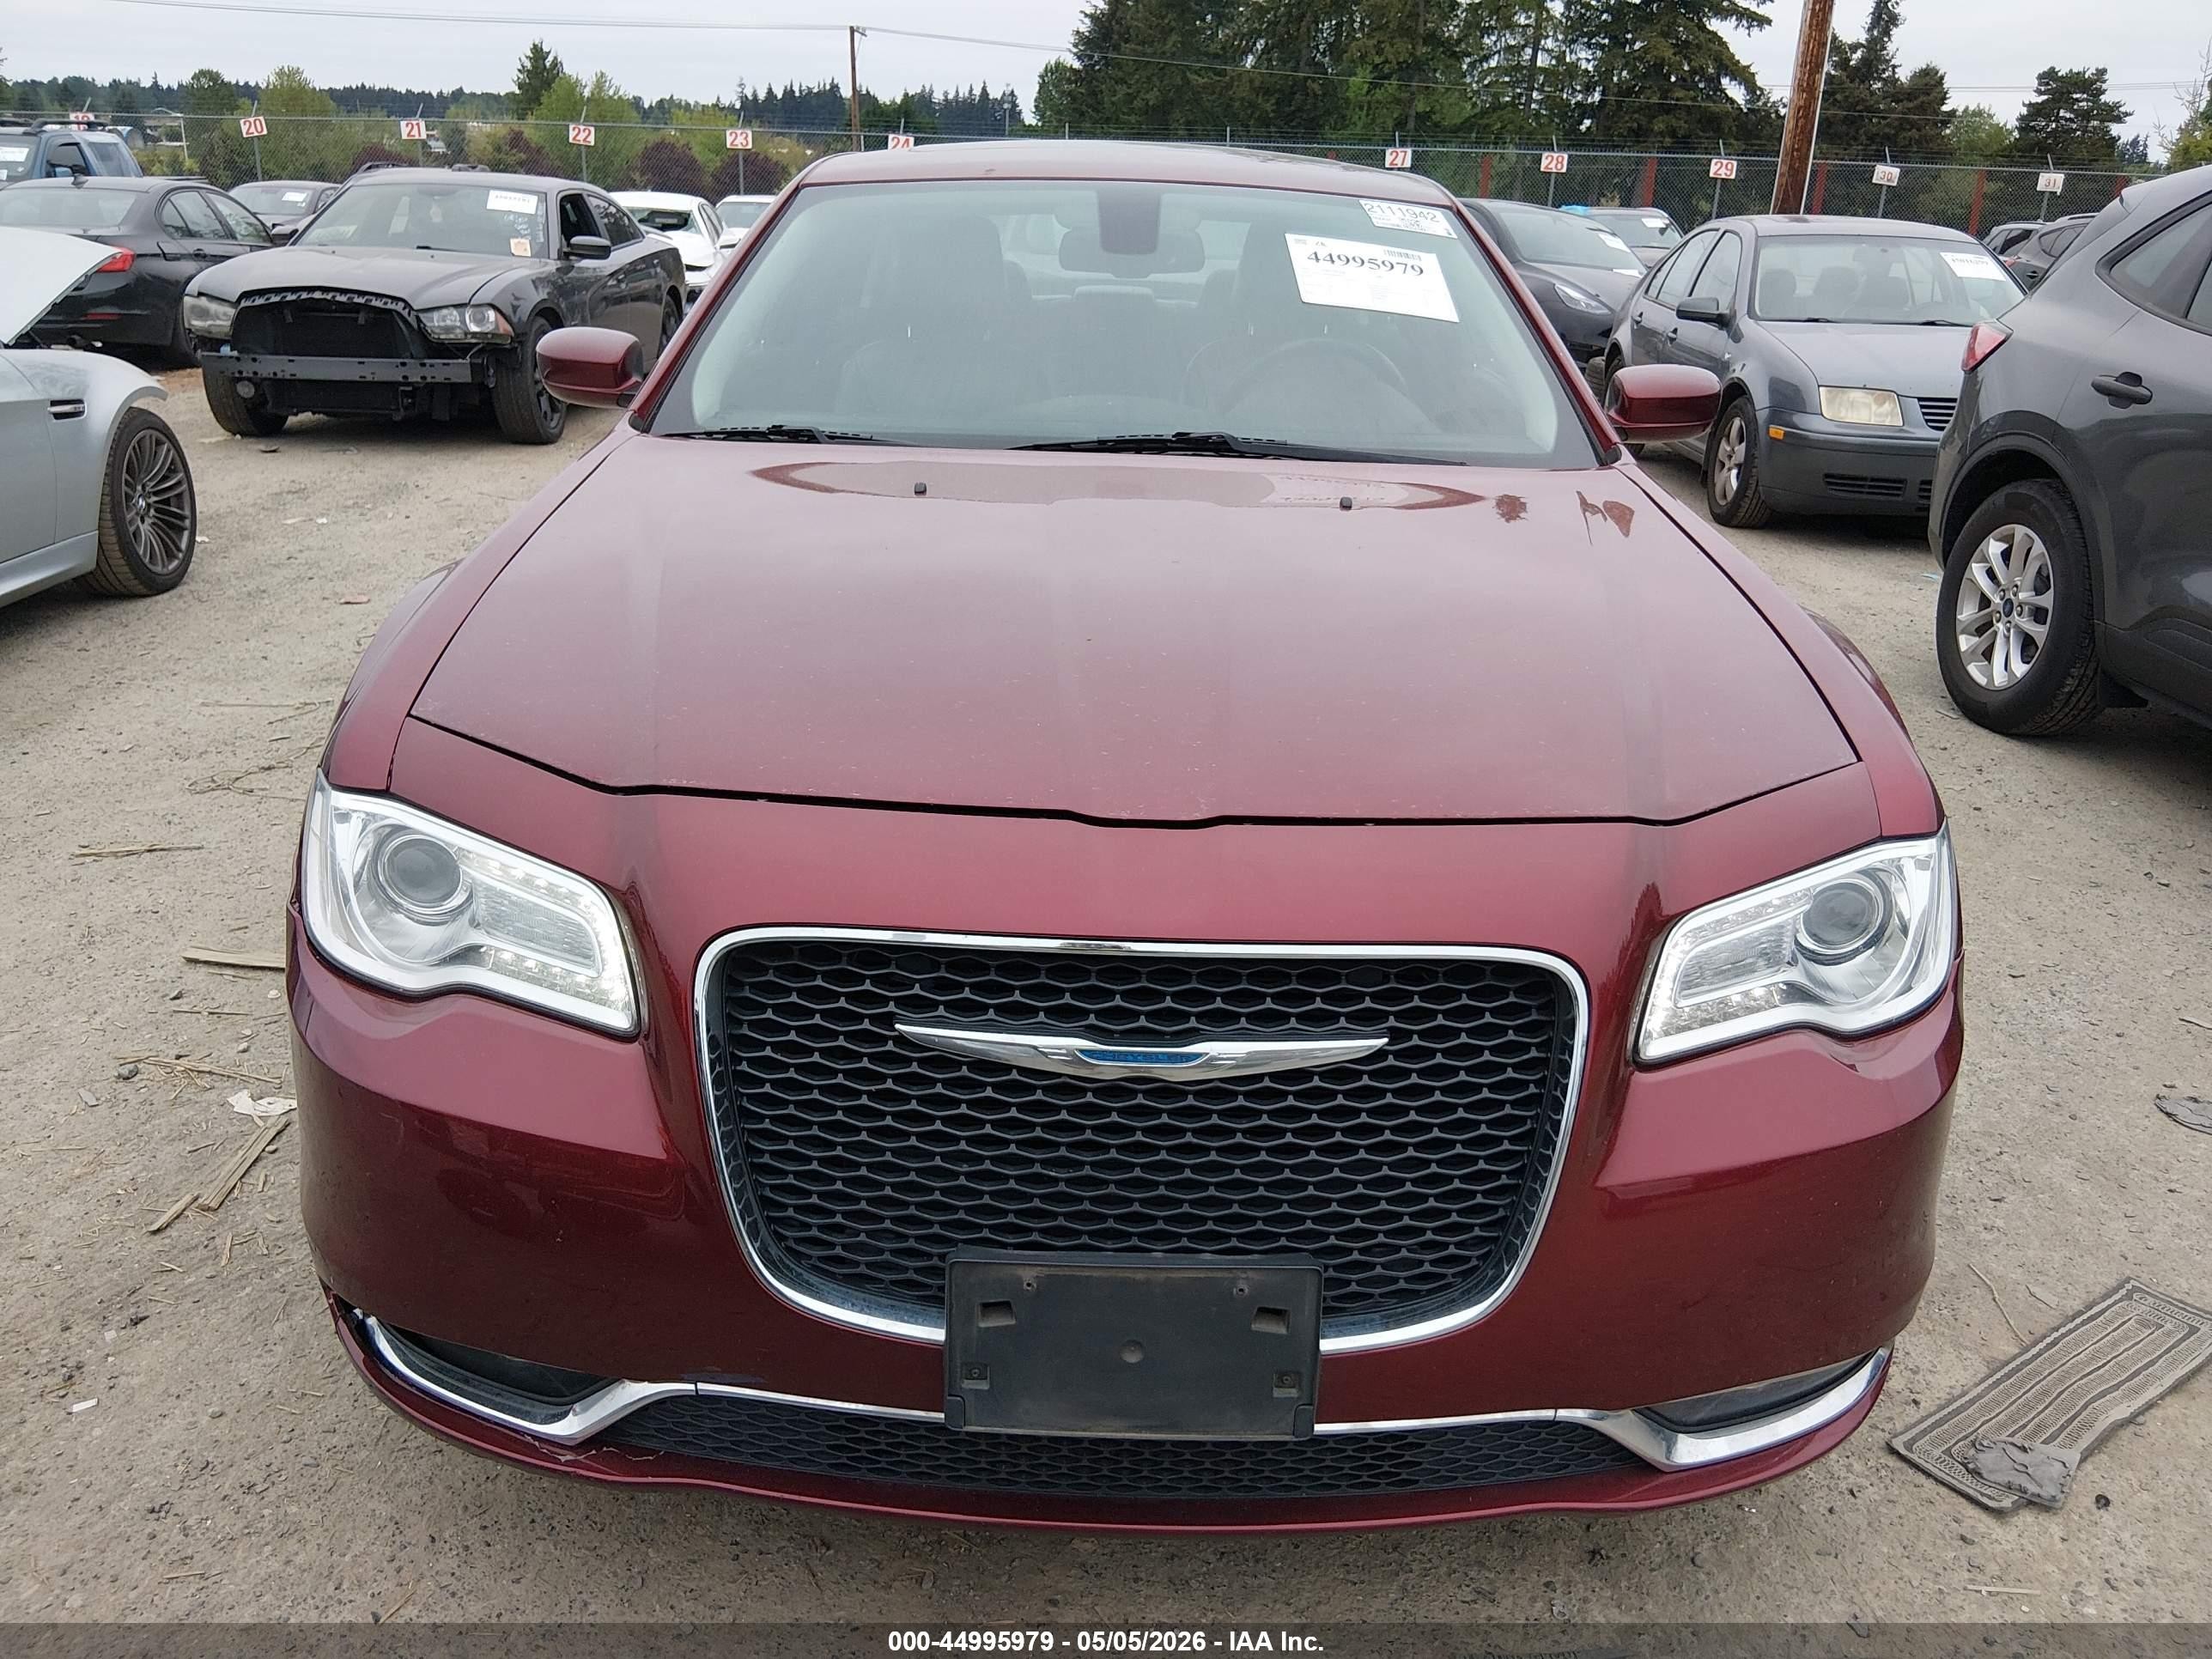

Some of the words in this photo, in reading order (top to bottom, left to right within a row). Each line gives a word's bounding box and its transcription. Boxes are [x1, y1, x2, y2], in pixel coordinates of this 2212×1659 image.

[243, 118, 264, 136] 20
[405, 122, 422, 137] 21
[572, 126, 591, 143] 22
[729, 131, 749, 147] 23
[891, 137, 910, 149] 24
[1389, 150, 1407, 167] 27
[1544, 155, 1565, 171] 28
[1713, 161, 1735, 177] 29
[1880, 171, 1893, 181] 30
[2044, 178, 2056, 188] 31
[1364, 204, 1440, 222] 2111942
[1307, 250, 1425, 276] 44995979
